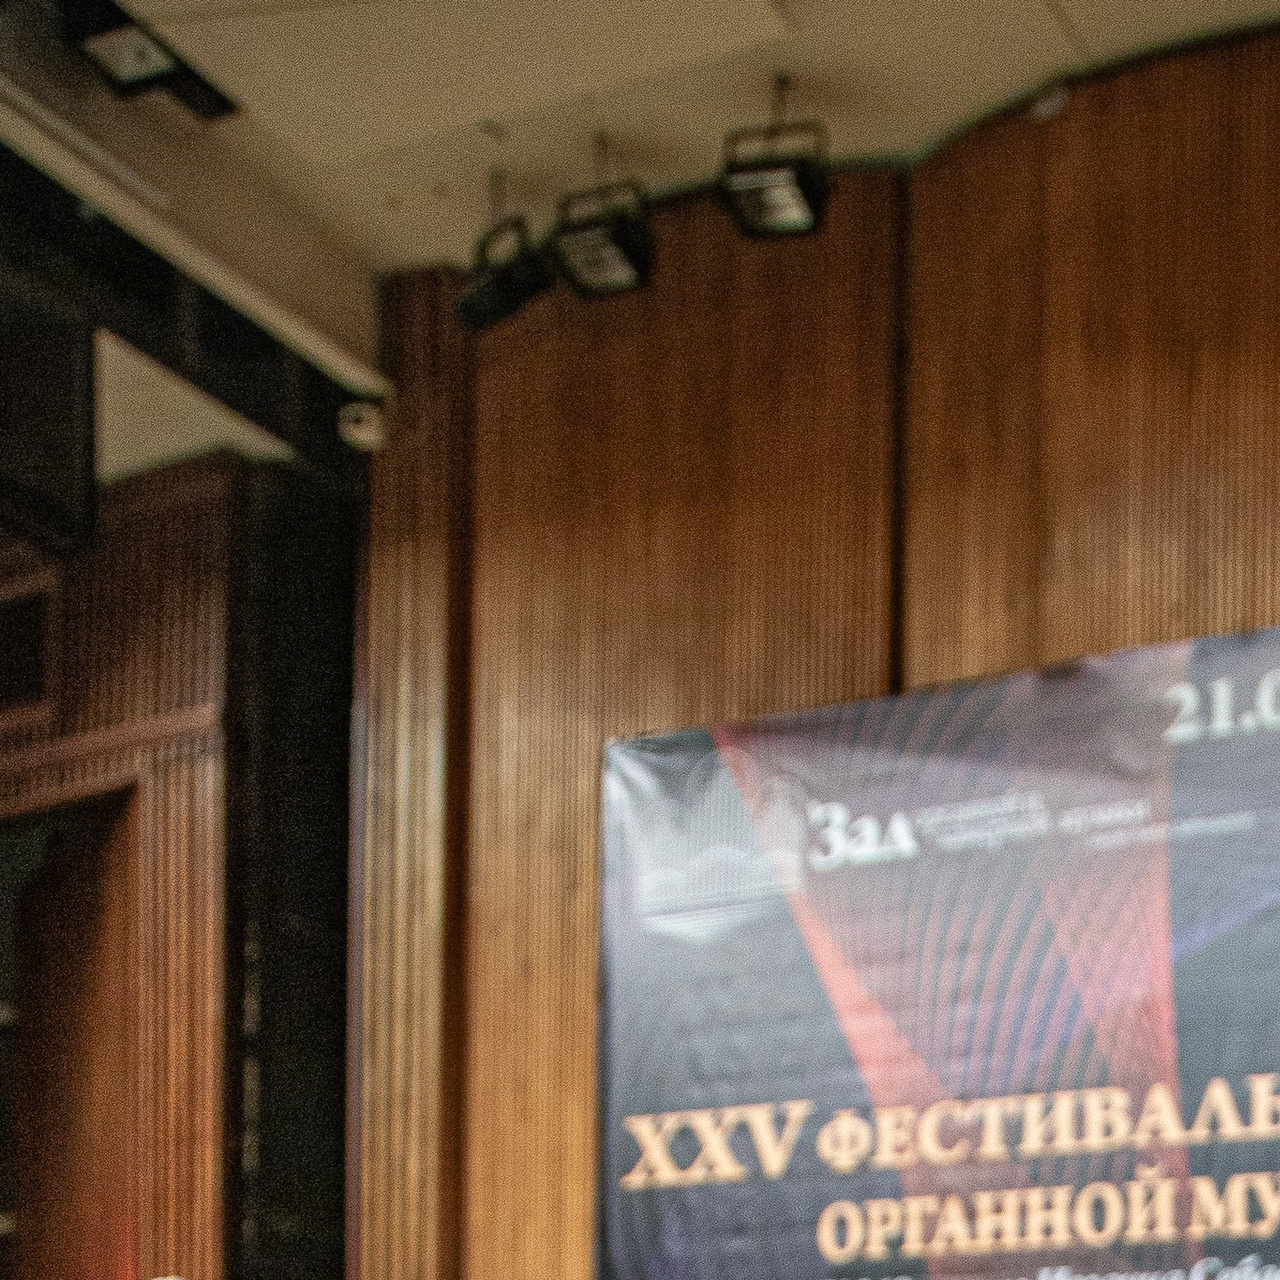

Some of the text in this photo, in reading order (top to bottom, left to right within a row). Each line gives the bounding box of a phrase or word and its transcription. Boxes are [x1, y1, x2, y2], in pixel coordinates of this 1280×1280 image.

[808, 803, 918, 872] Зал
[620, 1098, 813, 1192] XXV
[816, 1165, 1179, 1264] ОРГАННОЙ
